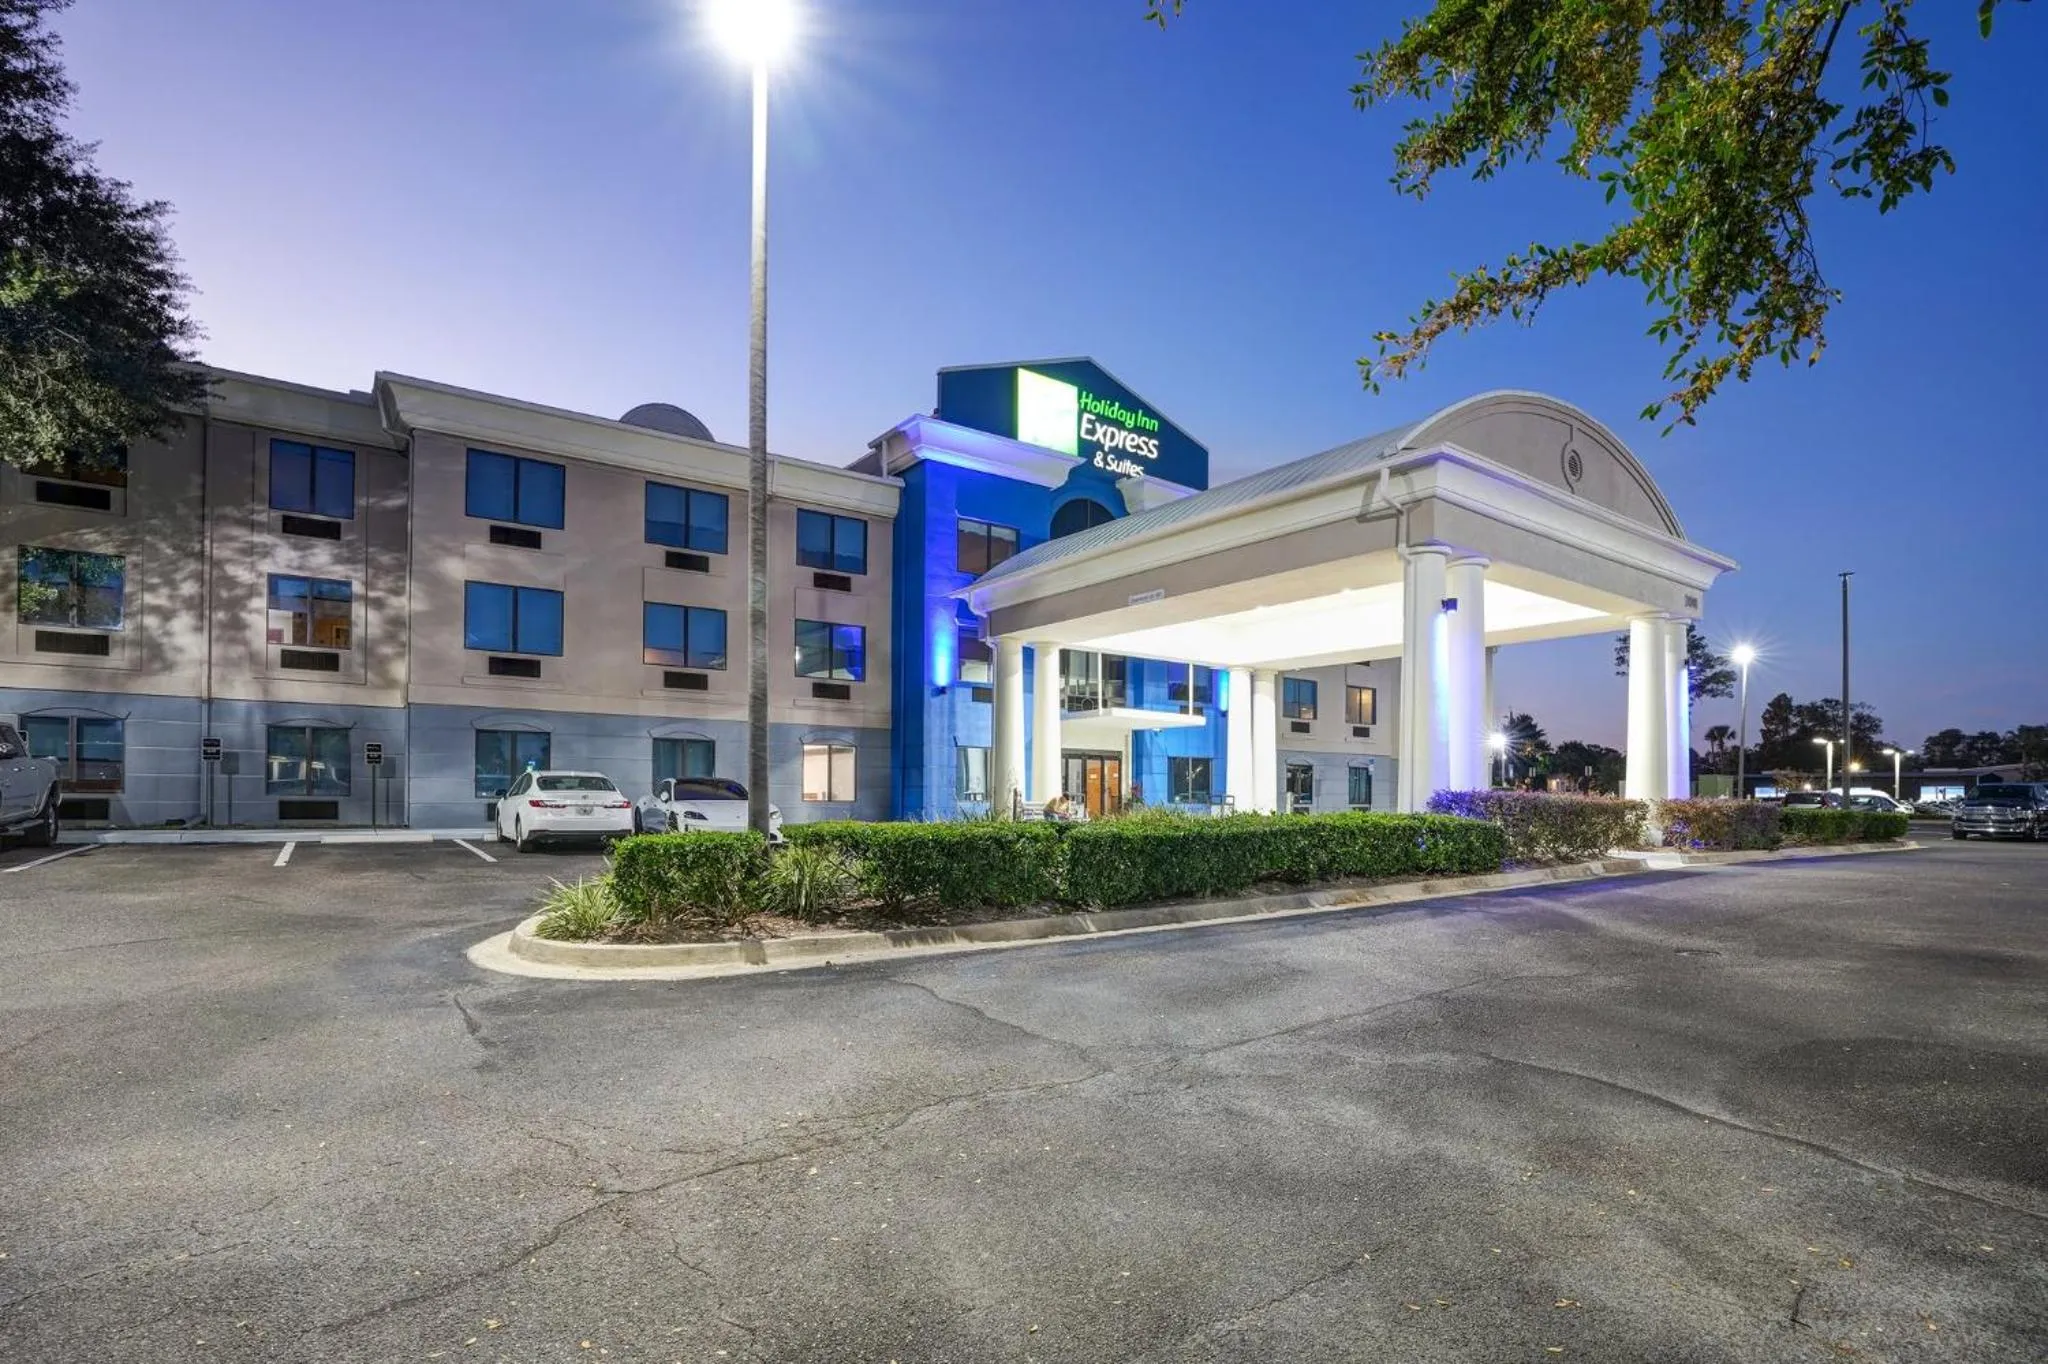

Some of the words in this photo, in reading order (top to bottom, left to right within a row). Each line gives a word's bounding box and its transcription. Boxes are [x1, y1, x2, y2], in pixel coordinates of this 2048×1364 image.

[1080, 391, 1135, 428] Holiday
[1137, 409, 1159, 432] Inn
[1080, 412, 1159, 459] Express
[1093, 450, 1104, 469] &
[1105, 454, 1144, 477] Suites
